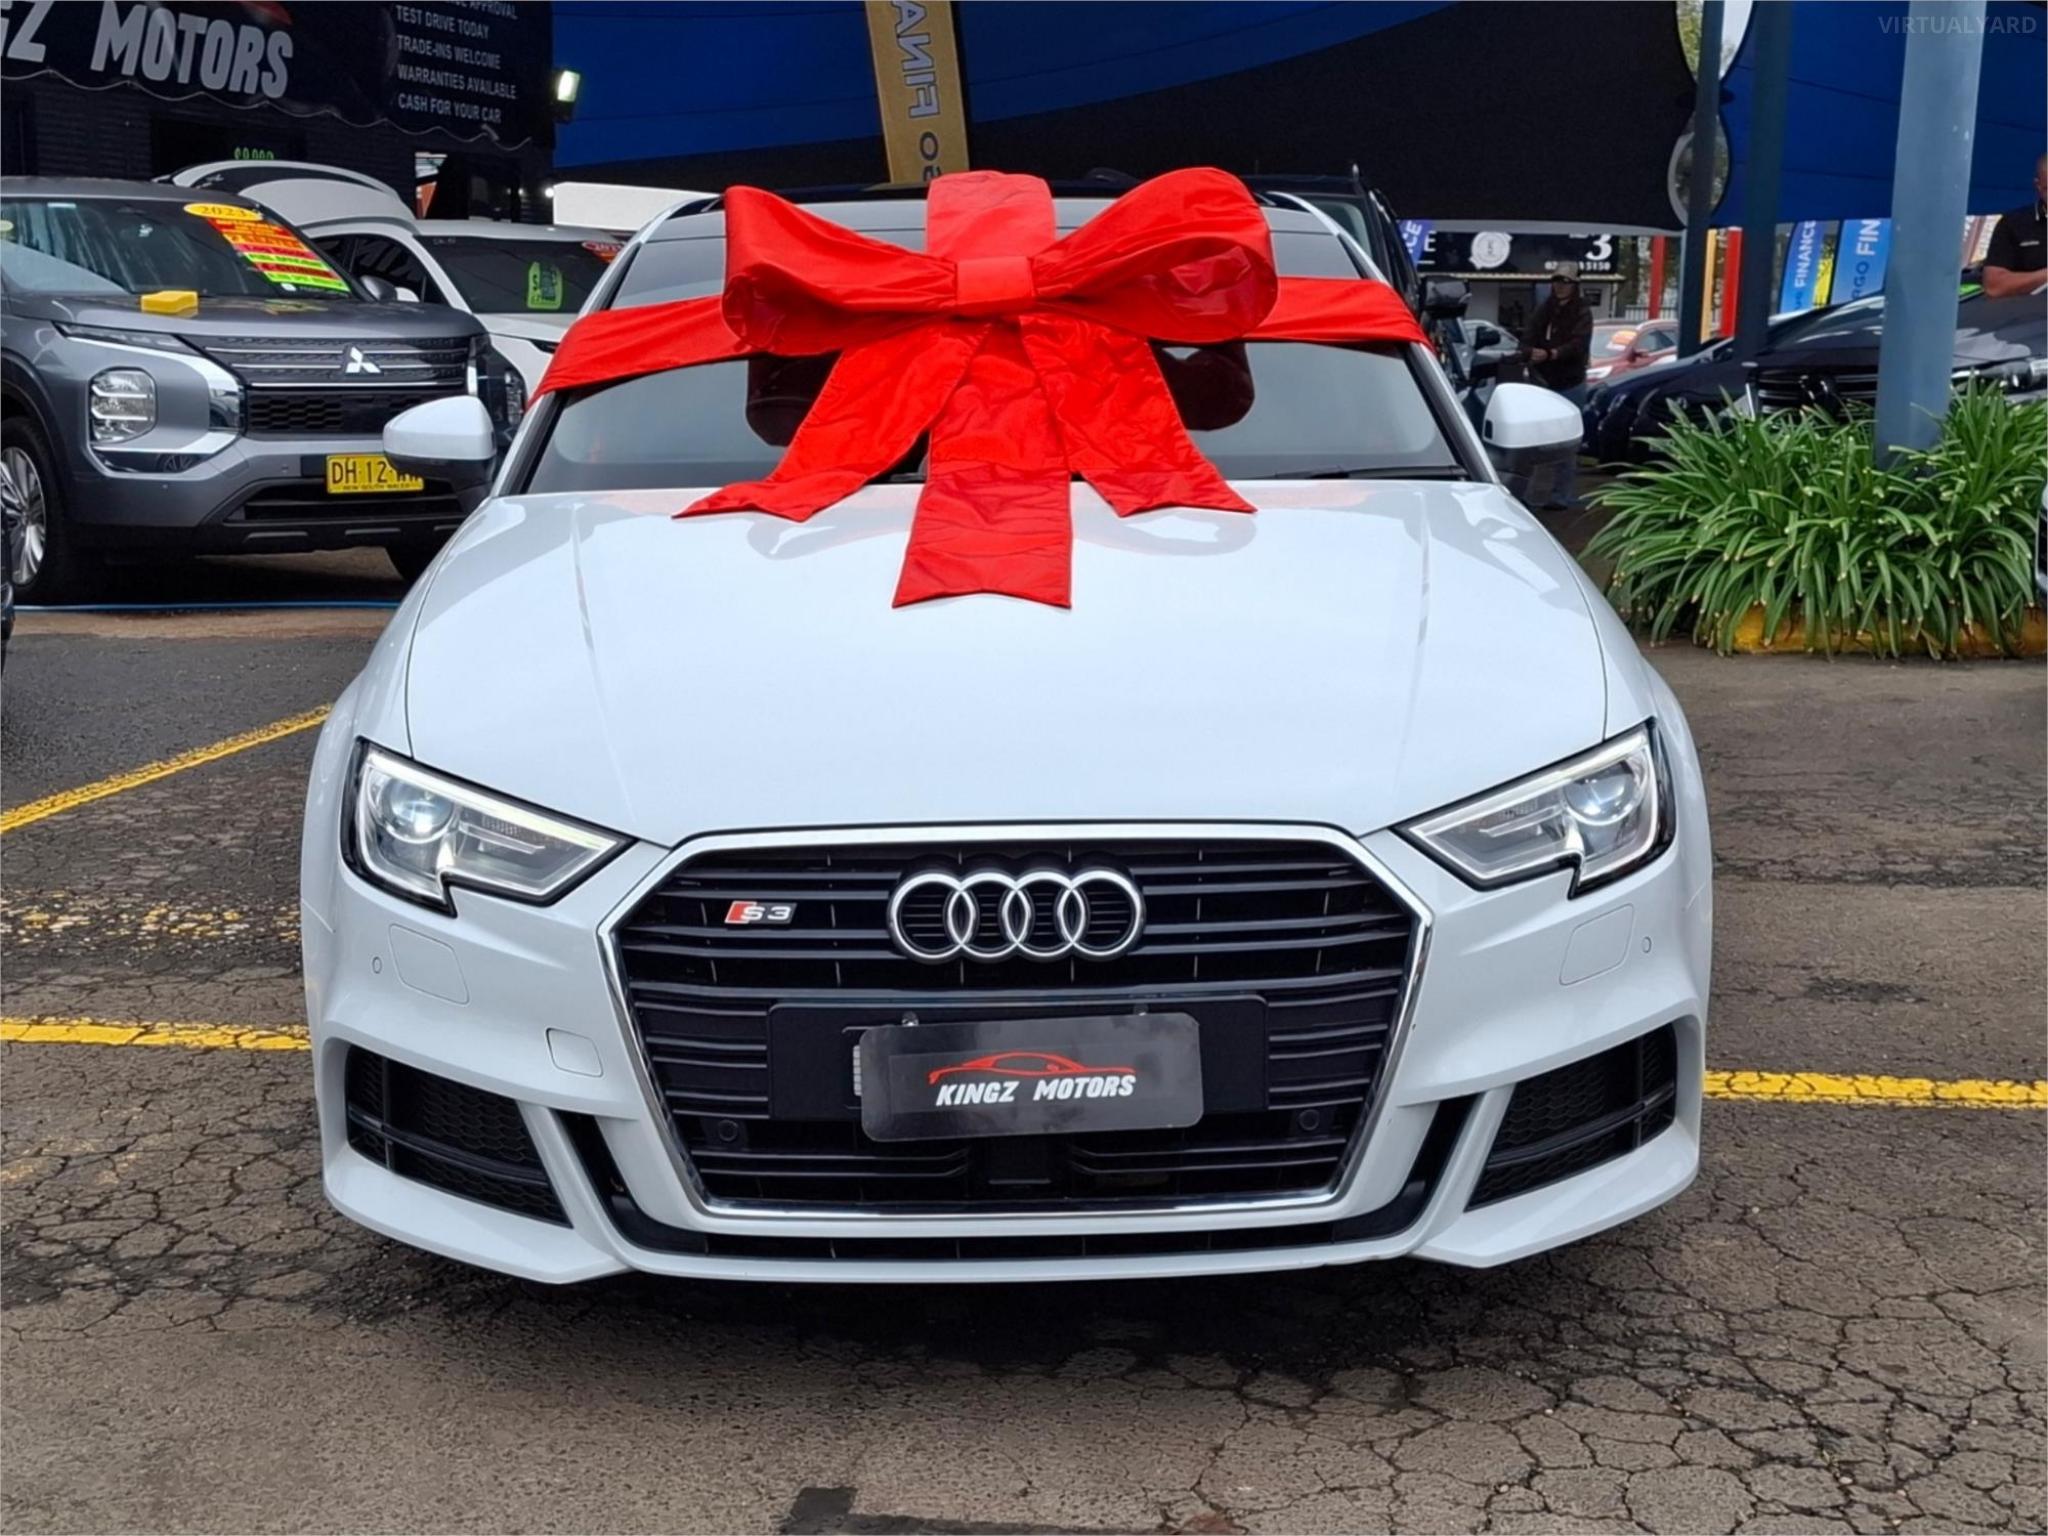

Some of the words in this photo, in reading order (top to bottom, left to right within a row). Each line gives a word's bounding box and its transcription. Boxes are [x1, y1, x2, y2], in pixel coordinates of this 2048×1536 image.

[396, 5, 422, 25] TEST
[425, 11, 455, 32] DRIVE
[458, 18, 490, 39] TODAY
[0, 0, 53, 63] Z
[90, 0, 293, 98] MOTORS
[397, 34, 452, 60] TRADE-INS
[454, 45, 501, 70] WELCOME
[397, 63, 465, 90] WARRANTIES
[467, 77, 517, 99] AVAILABLE
[398, 92, 428, 112] CASH
[430, 98, 452, 115] FOR
[454, 102, 480, 120] YOUR
[482, 107, 502, 123] CAR
[741, 906, 792, 920] S3
[936, 1081, 1020, 1106] KINGZ
[1033, 1075, 1136, 1101] MOTORS
